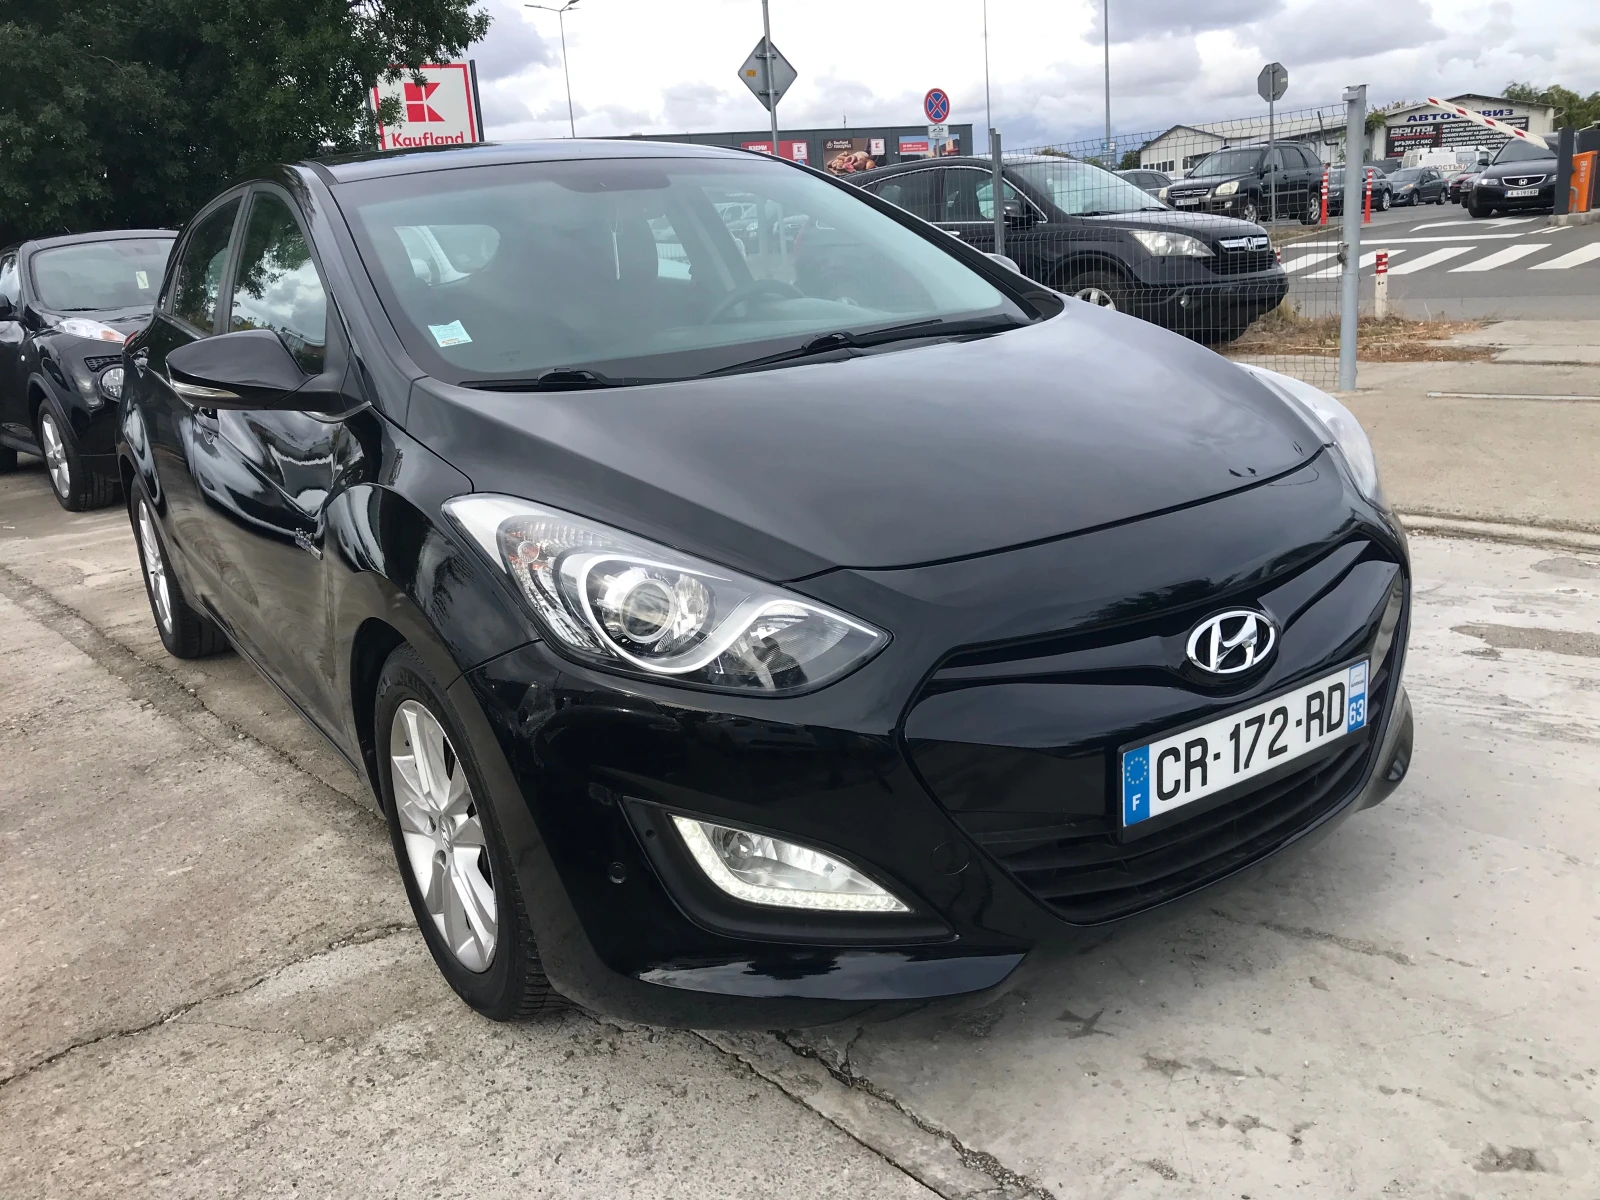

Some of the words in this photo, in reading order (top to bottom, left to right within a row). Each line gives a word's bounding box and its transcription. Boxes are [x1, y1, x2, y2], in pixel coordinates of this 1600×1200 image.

[391, 131, 464, 147] Kaufland
[1349, 699, 1364, 725] 63
[1156, 681, 1346, 801] CR-172-RD
[1132, 793, 1141, 812] F
